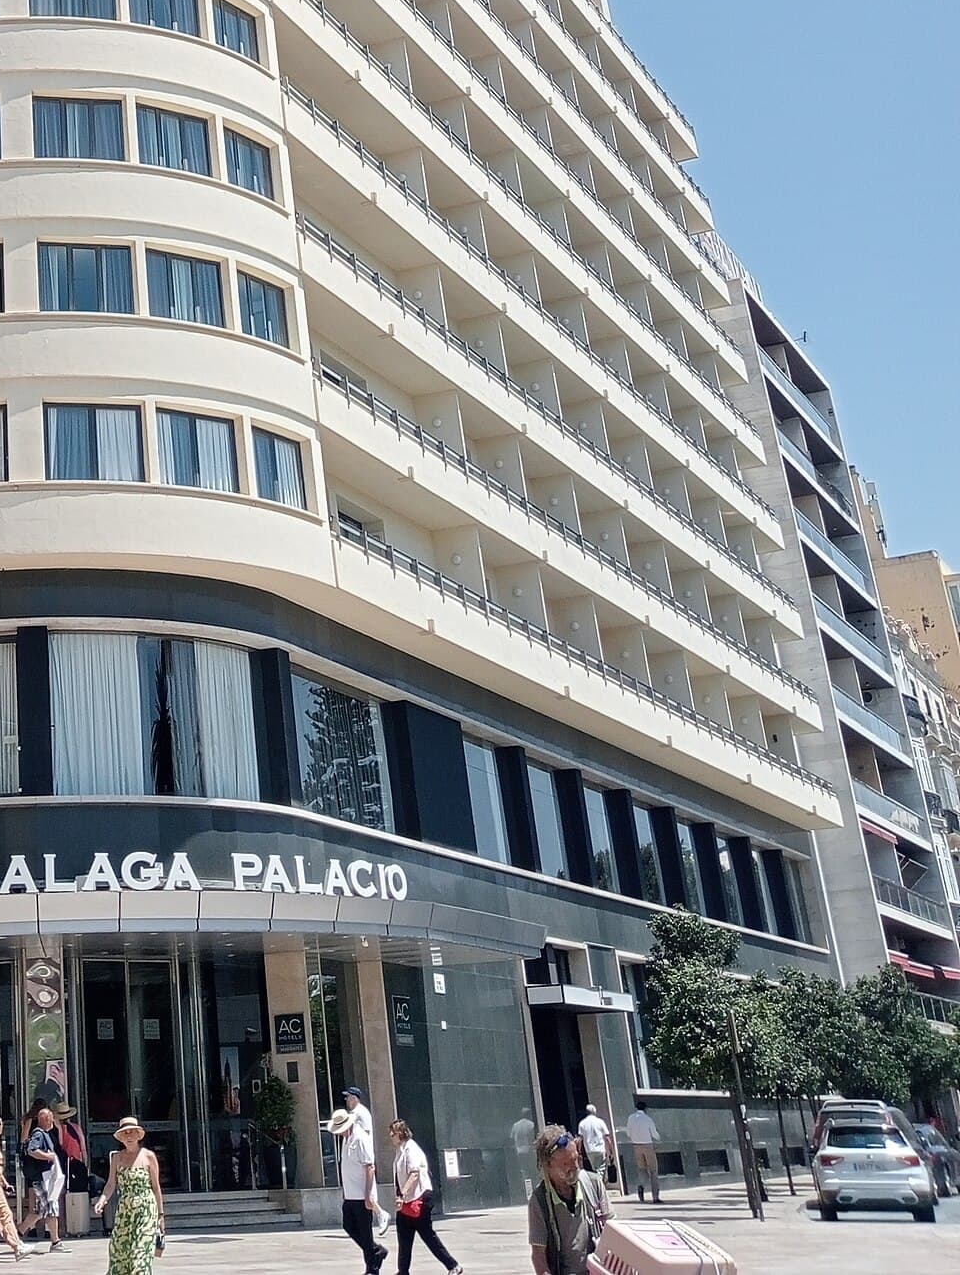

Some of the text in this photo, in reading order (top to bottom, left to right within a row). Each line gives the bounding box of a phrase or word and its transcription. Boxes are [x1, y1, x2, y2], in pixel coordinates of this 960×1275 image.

[230, 852, 409, 902] PALACIO
[396, 1002, 410, 1021] AC
[278, 1018, 301, 1034] AC
